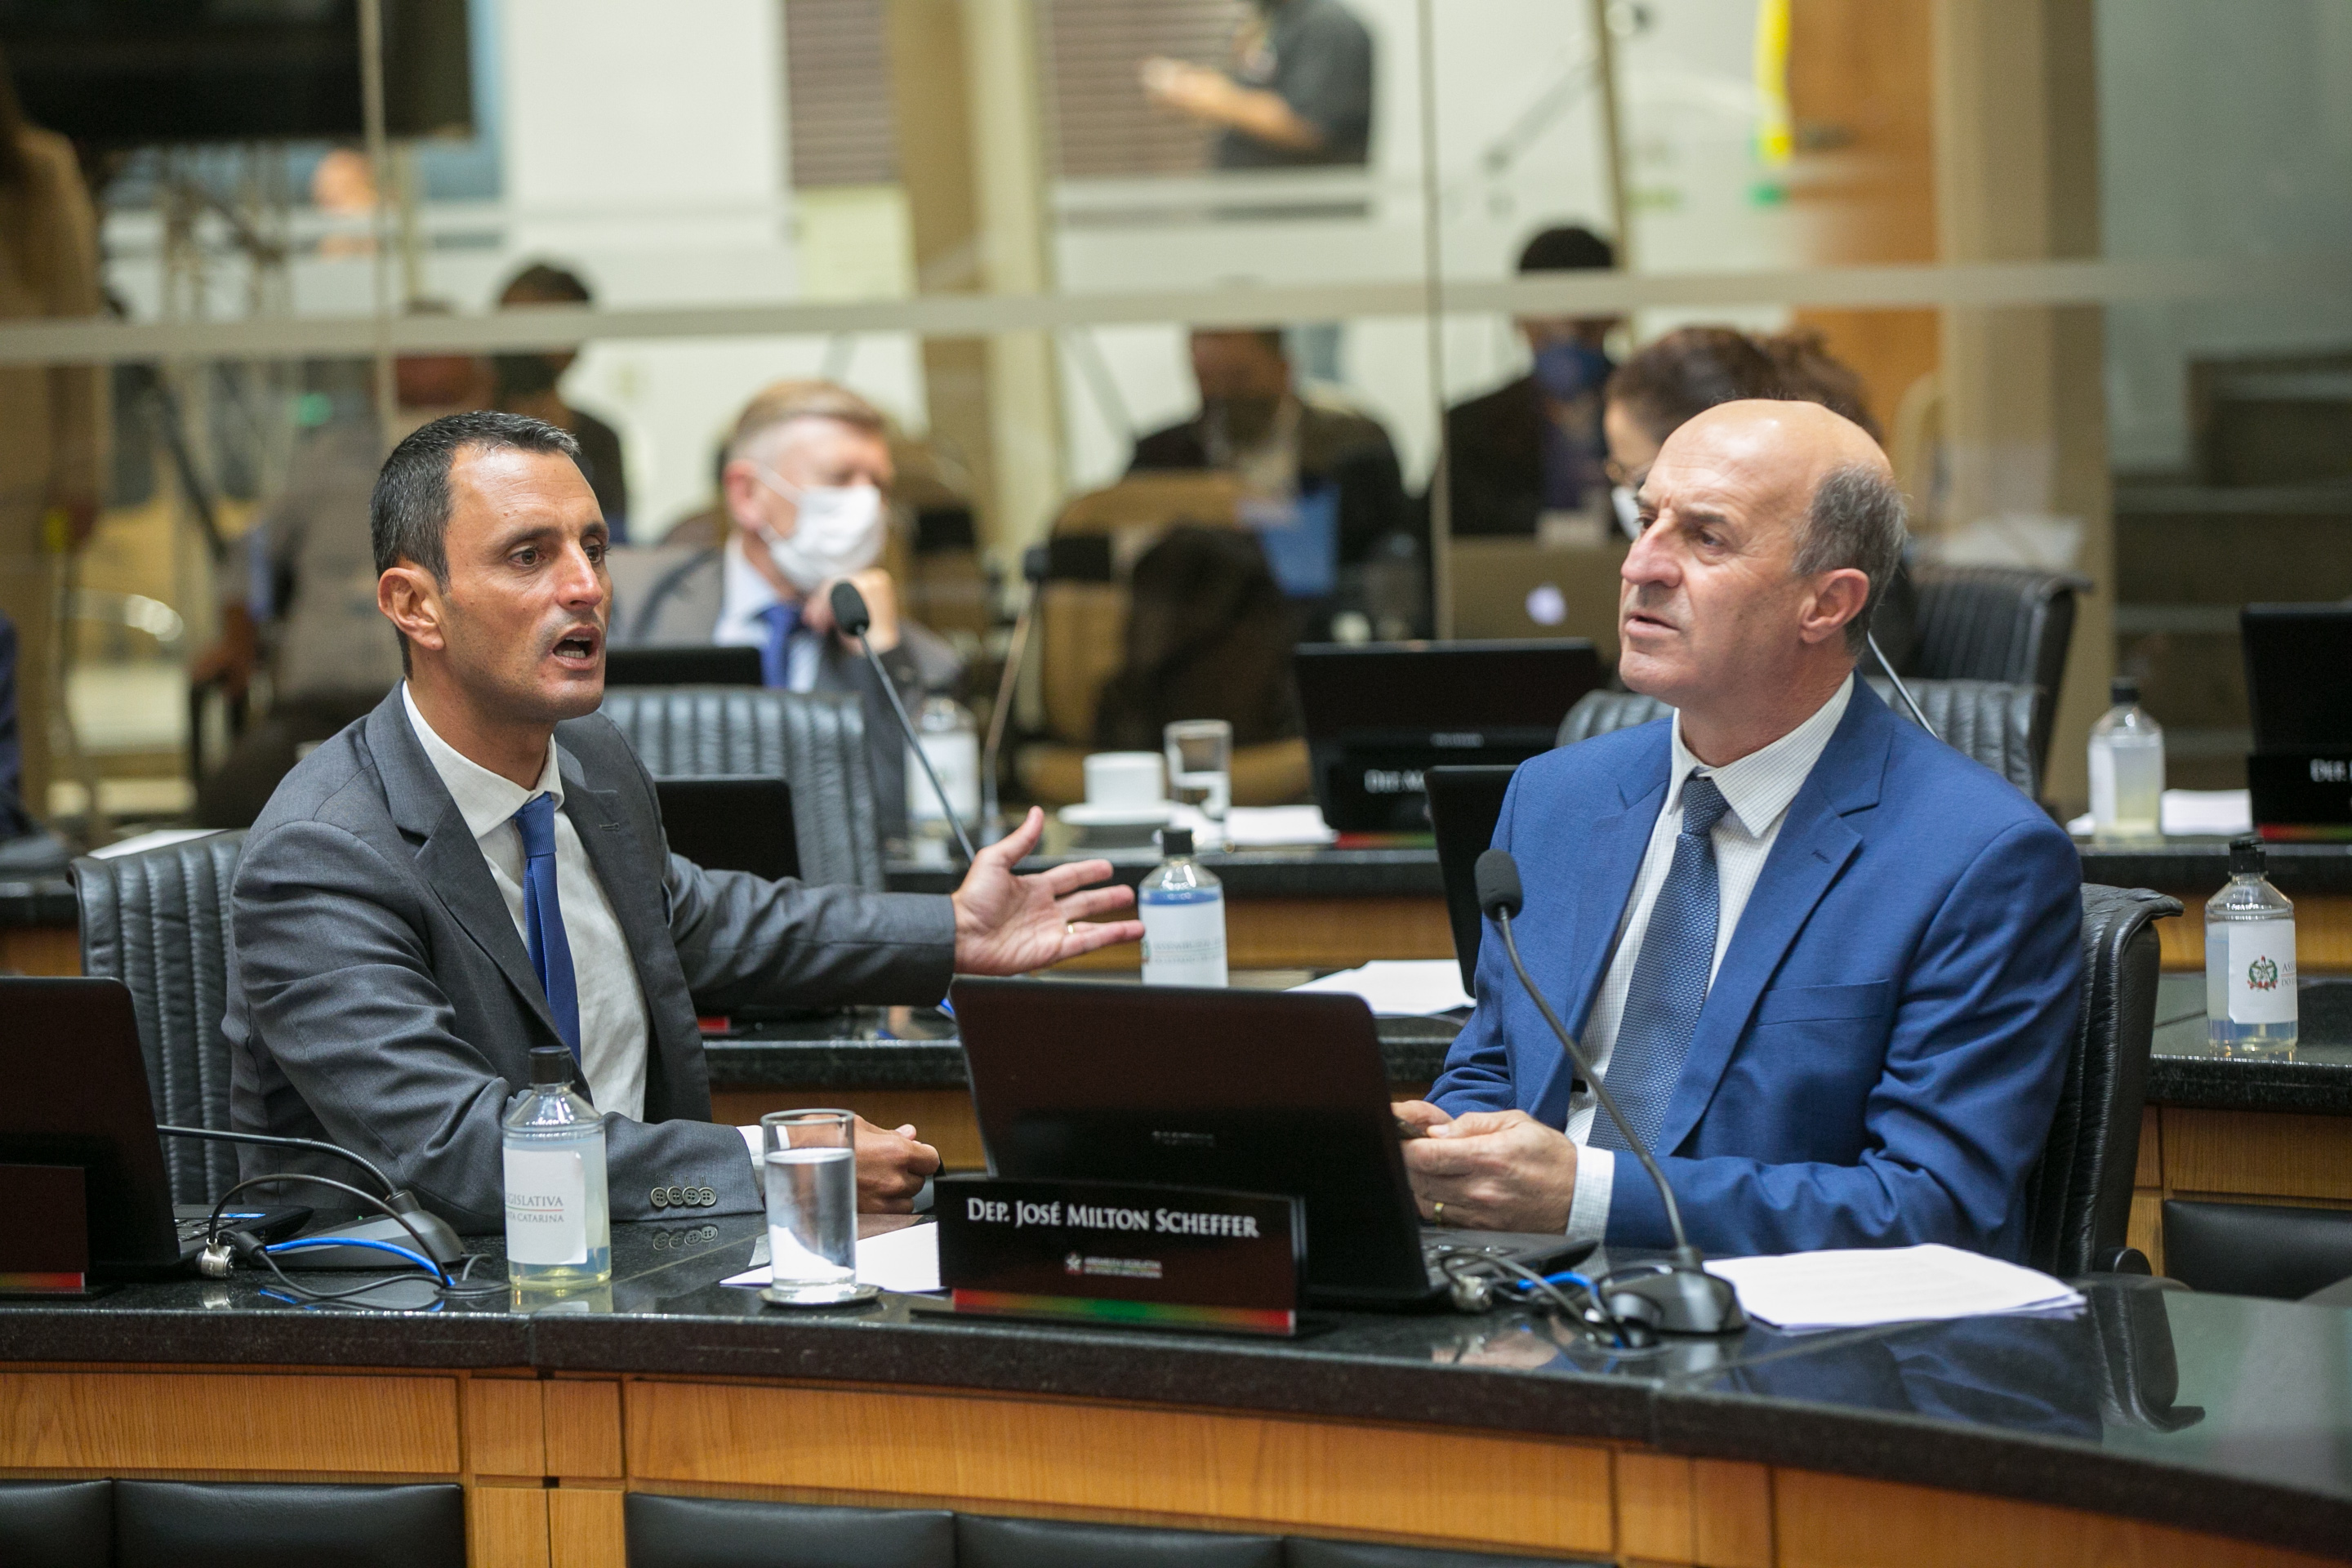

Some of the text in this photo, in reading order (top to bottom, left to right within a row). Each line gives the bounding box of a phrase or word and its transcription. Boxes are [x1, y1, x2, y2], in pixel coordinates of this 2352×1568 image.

[517, 1213, 564, 1223] CATARINA
[967, 1197, 1260, 1238] DEP. JOSÉ MILTON SCHEFFER
